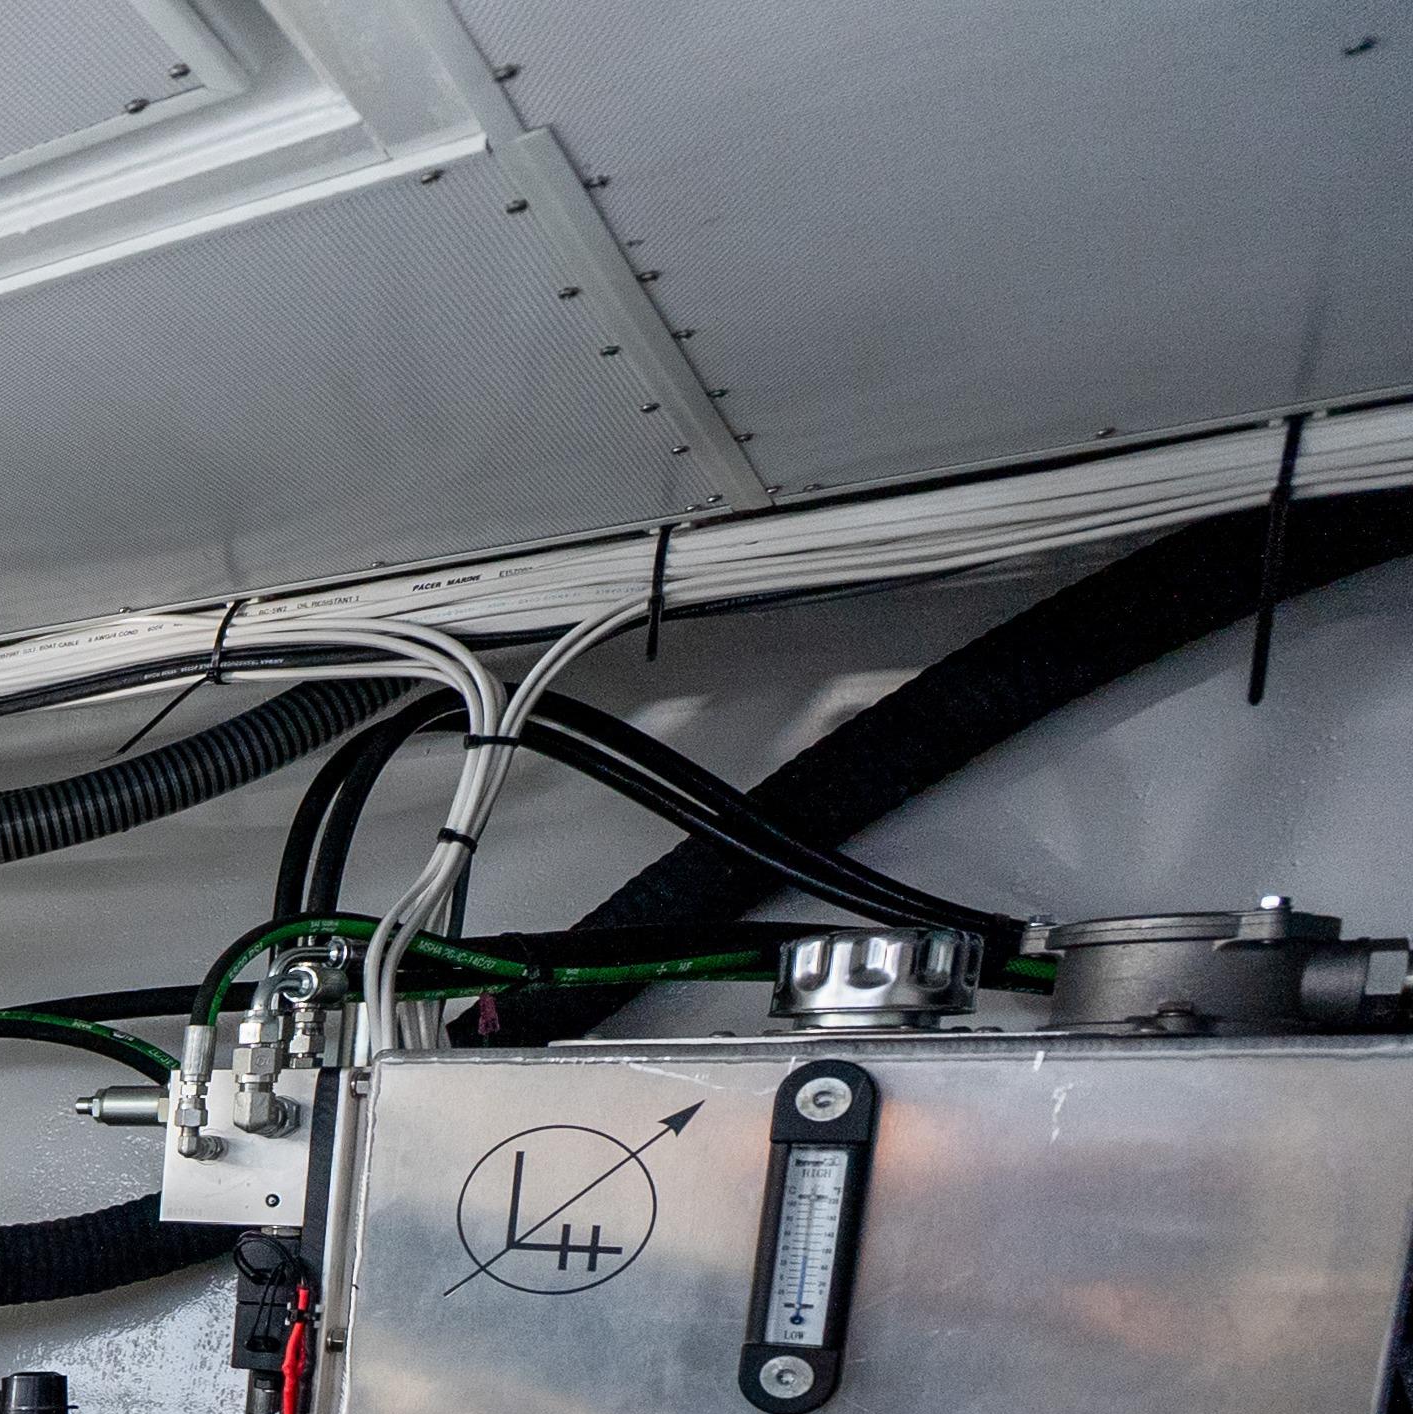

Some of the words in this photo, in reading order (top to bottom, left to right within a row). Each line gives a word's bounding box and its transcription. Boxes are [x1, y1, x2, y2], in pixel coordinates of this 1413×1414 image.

[412, 580, 442, 592] PACER
[446, 575, 482, 586] MARINE
[784, 1330, 805, 1340] LOW
